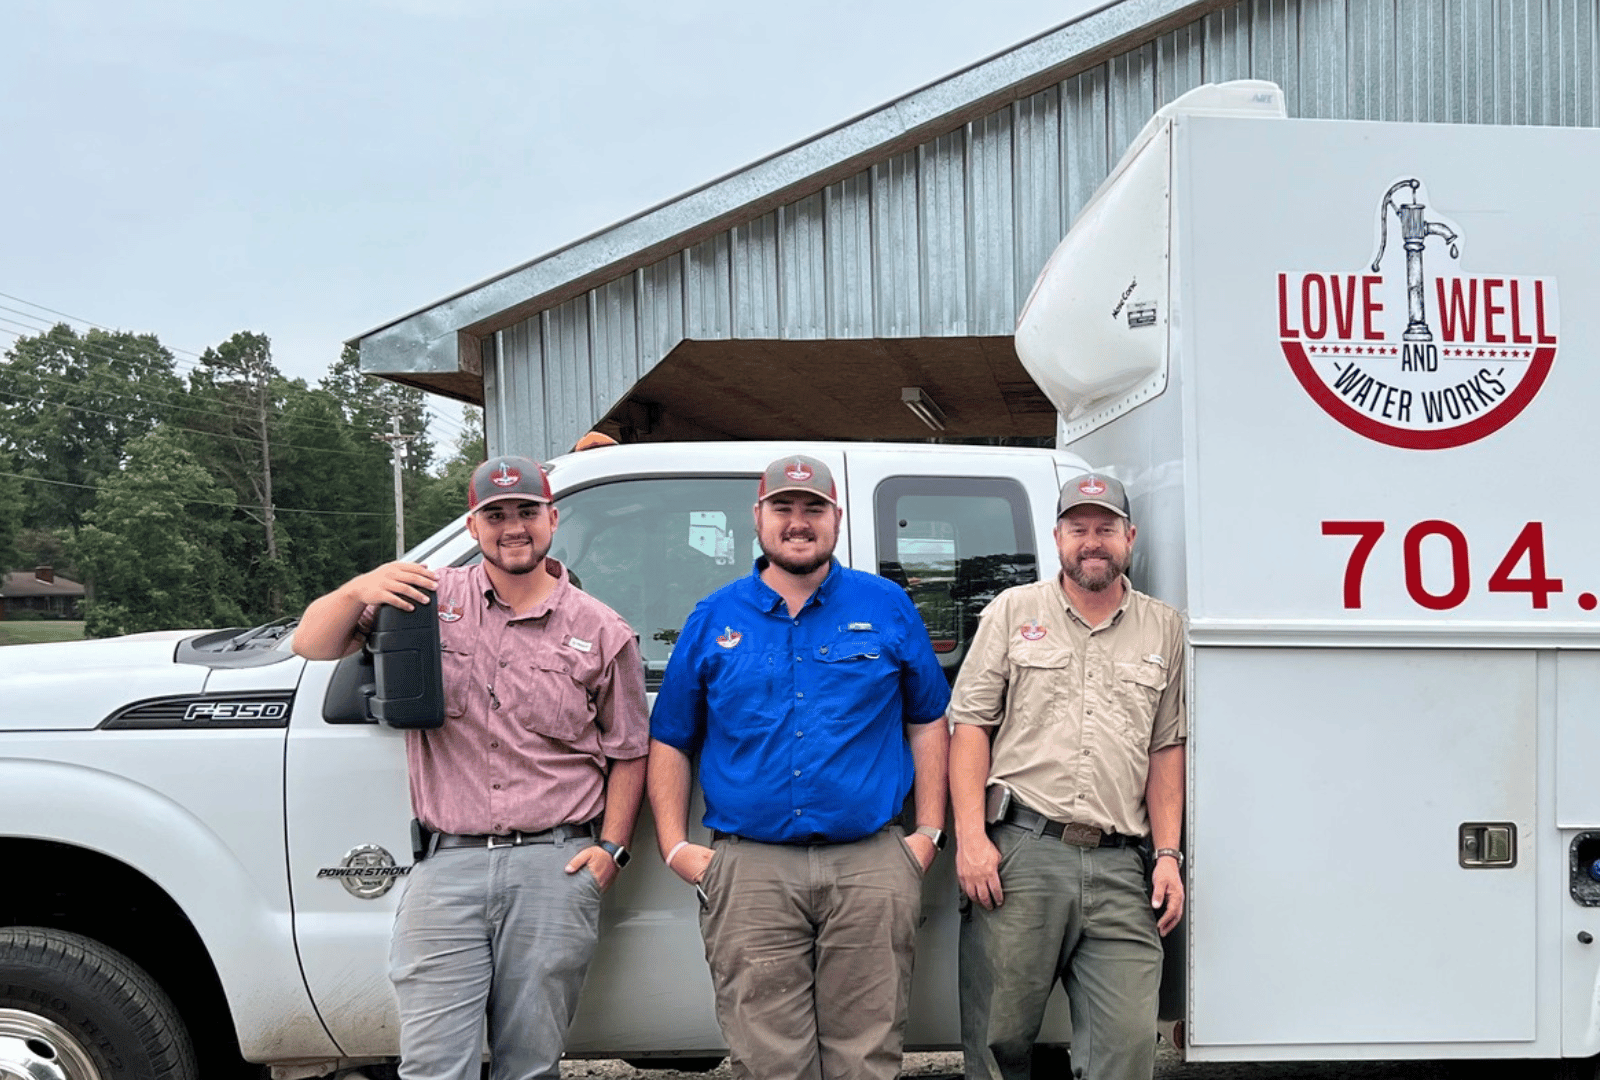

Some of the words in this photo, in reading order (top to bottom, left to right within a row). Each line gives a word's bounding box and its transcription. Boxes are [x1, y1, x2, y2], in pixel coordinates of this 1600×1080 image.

[1278, 273, 1385, 340] LOVE
[1435, 277, 1557, 344] WELL
[1401, 344, 1438, 372] AND
[1321, 519, 1598, 610] 704.
[183, 702, 288, 720] F-350
[317, 867, 363, 878] POWER
